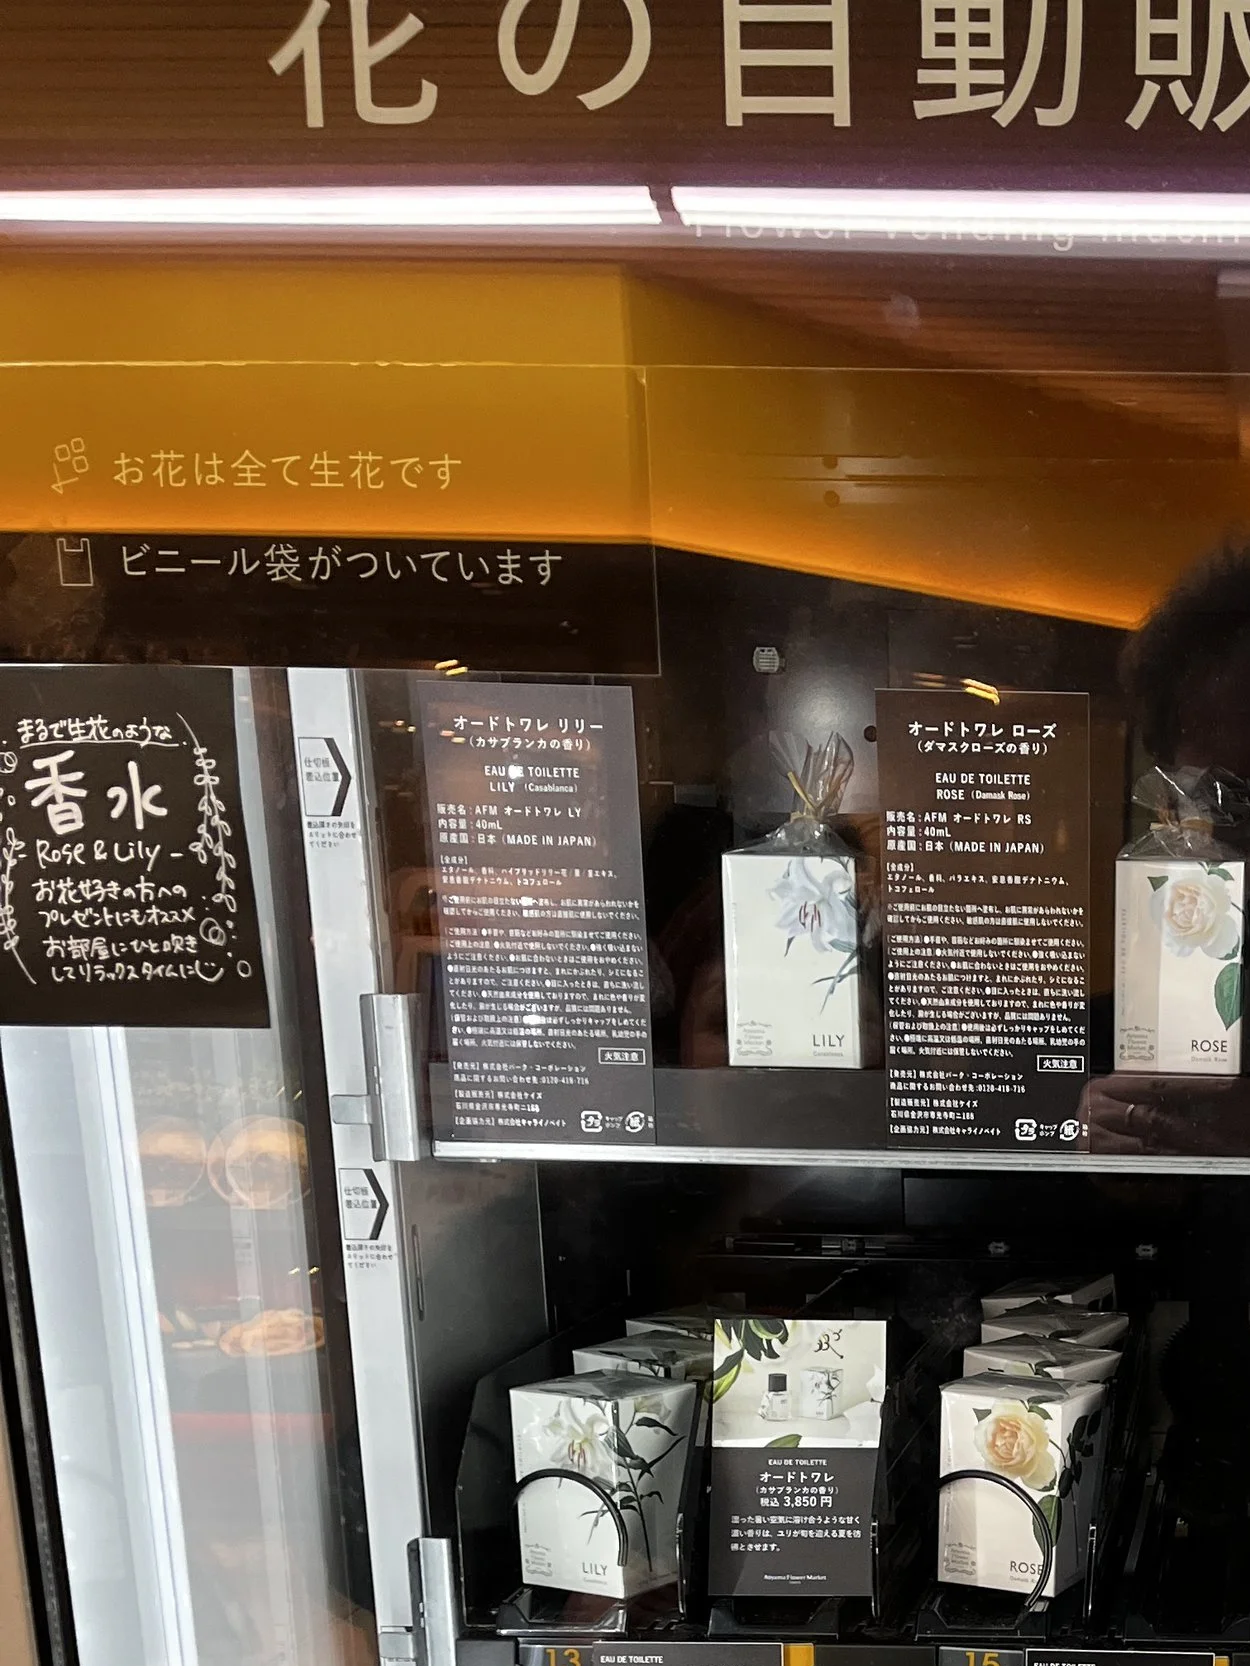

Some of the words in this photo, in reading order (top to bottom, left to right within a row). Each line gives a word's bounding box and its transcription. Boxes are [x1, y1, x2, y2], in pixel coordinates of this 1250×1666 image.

[113, 449, 463, 491] お花は全て生花です
[118, 543, 563, 589] ビニール袋がついています
[17, 714, 172, 744] まるで生花のような
[453, 715, 549, 733] オードトワレ
[558, 718, 603, 734] リリー
[908, 721, 1004, 738] オードトワレ
[1012, 722, 1058, 739] ローズ
[469, 735, 591, 752] （カサブランカの香り）
[917, 739, 1048, 755] （ダマスクローズの香り）
[935, 772, 957, 784] EAU
[960, 773, 975, 784] DE
[978, 773, 1031, 785] TOILETTE
[25, 750, 168, 835] 香水
[953, 812, 1012, 825] オードトワレ
[1017, 813, 1032, 825] RS
[36, 840, 86, 869] Rose
[114, 840, 161, 872] Lily
[31, 876, 187, 904] お花好きの方への
[38, 905, 196, 929] プレゼントにもオススメ
[42, 933, 197, 961] お部屋にひと吹き
[51, 962, 197, 983] してリラックスタイムに
[812, 1033, 846, 1048] LILY
[1190, 1039, 1228, 1053] ROSE
[760, 1471, 835, 1483] オードトワレ
[760, 1496, 780, 1508] 税込
[783, 1495, 817, 1508] 3,850
[820, 1495, 833, 1508] 円
[581, 1561, 608, 1577] LILY
[1009, 1560, 1044, 1577] ROSE
[600, 1655, 615, 1664] EAU
[616, 1655, 627, 1664] DE
[628, 1655, 663, 1664] TOILETTE
